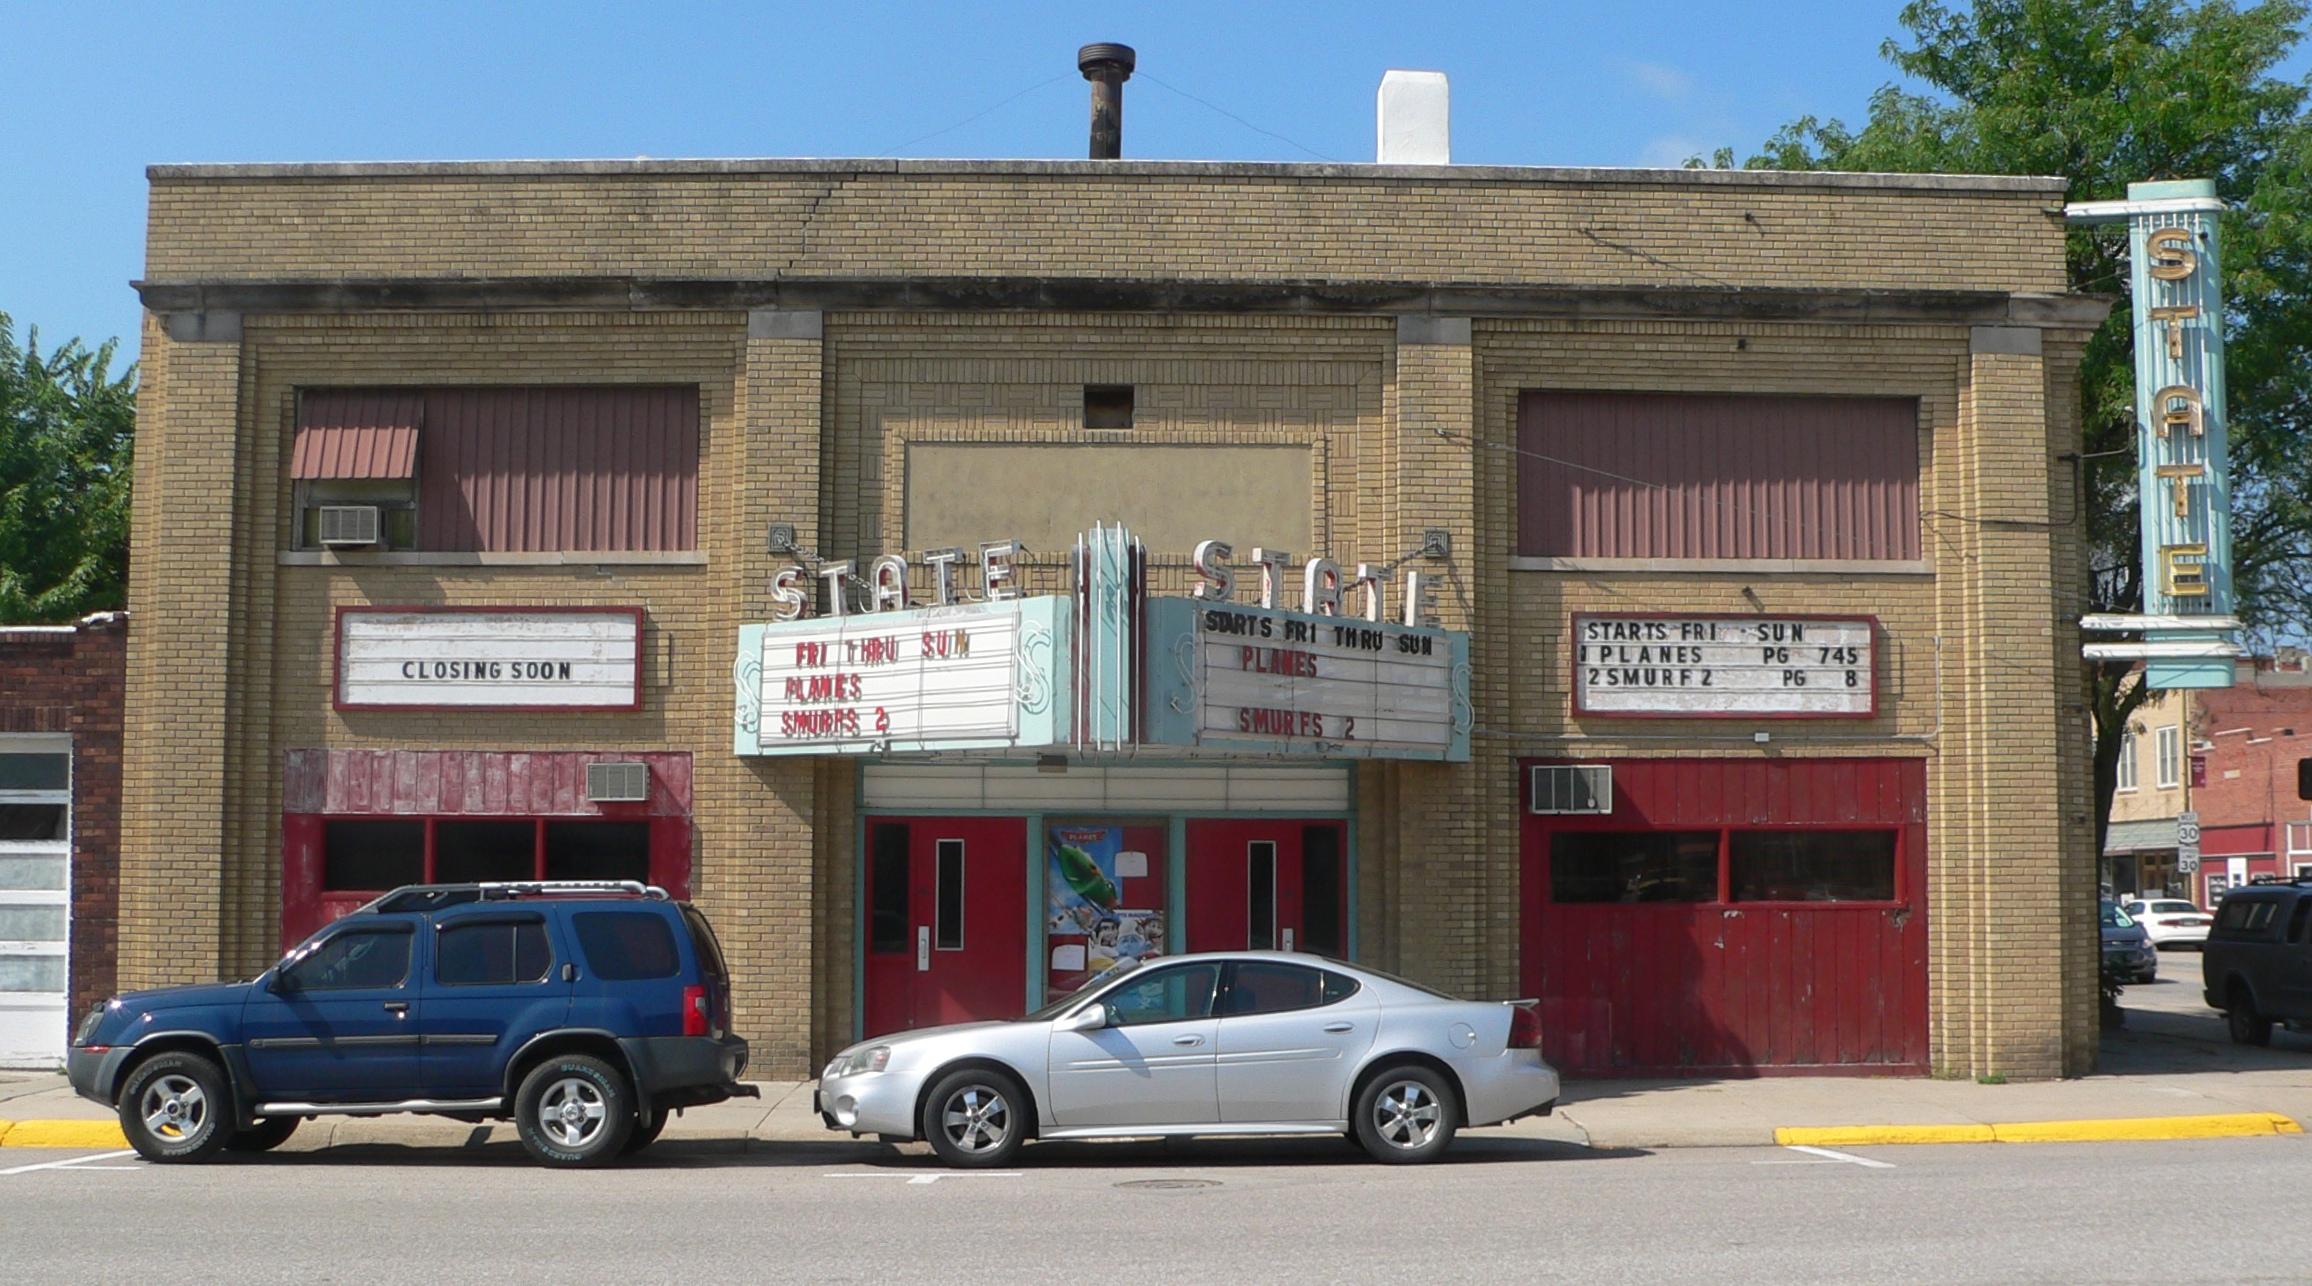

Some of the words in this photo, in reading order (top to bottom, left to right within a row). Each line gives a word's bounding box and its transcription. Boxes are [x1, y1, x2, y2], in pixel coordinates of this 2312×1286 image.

[2146, 226, 2209, 597] STATE
[770, 539, 1024, 622] STATE
[1193, 539, 1443, 629] STATE
[1205, 610, 1272, 638] STARTS
[1285, 619, 1316, 644] FRI
[1334, 626, 1383, 652] THRU
[1399, 633, 1432, 656] SUN
[1588, 622, 1667, 640] STARTS
[1681, 622, 1716, 641] FRI
[1758, 623, 1803, 642] SUN
[796, 641, 828, 668] FRI
[845, 635, 898, 666] THRU
[922, 628, 969, 658] SUN
[1242, 645, 1317, 678] PLANES
[1600, 645, 1702, 663] PLANES
[1763, 646, 1789, 664] PG
[1819, 646, 1858, 664] 745
[402, 661, 500, 680] CLOSING
[511, 661, 570, 680] SOON
[1607, 668, 1692, 686] SMURF
[1701, 668, 1712, 686] 2
[1783, 669, 1806, 687] PG
[1845, 669, 1857, 687] 8
[785, 673, 862, 702] PLANES
[781, 707, 860, 737] SMURFS
[875, 706, 889, 732] 2
[1240, 707, 1323, 737] SMURFS
[1344, 716, 1355, 740] 2
[2180, 828, 2198, 839] 30
[2181, 861, 2198, 870] 30
